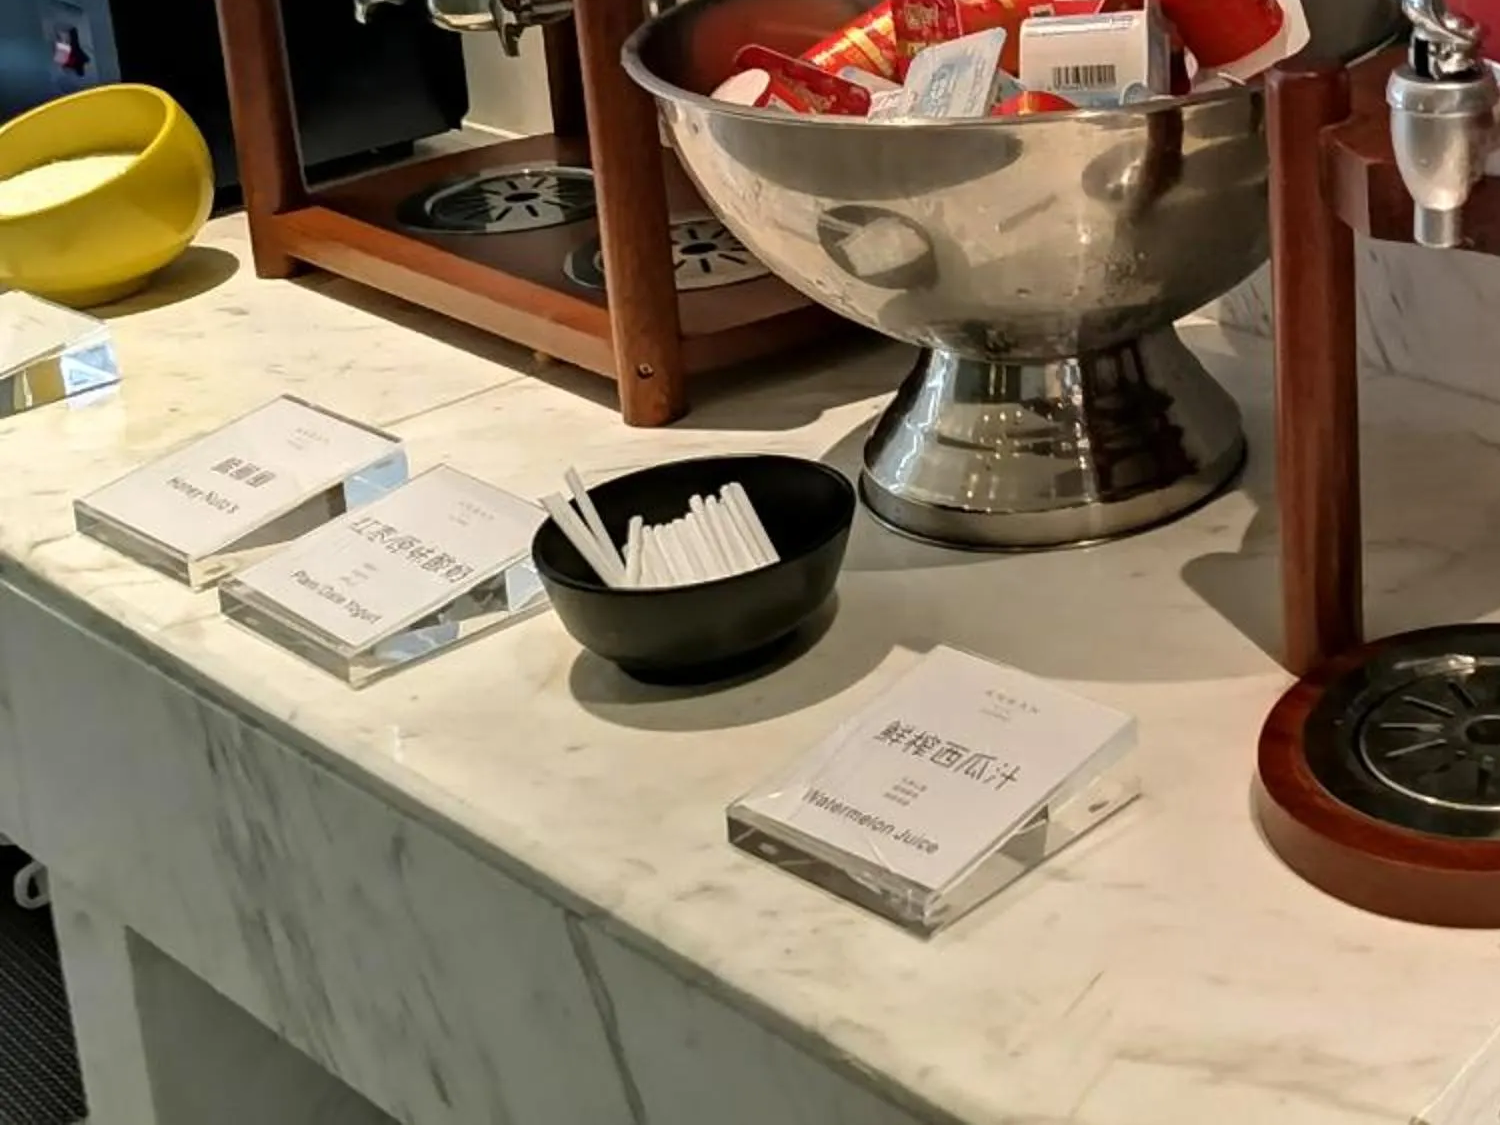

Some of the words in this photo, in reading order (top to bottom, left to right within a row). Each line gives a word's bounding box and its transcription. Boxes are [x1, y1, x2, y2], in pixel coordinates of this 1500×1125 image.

[872, 719, 1021, 792] 鲜榨西瓜汁
[802, 786, 896, 837] Watermelon
[893, 827, 939, 856] Juice
